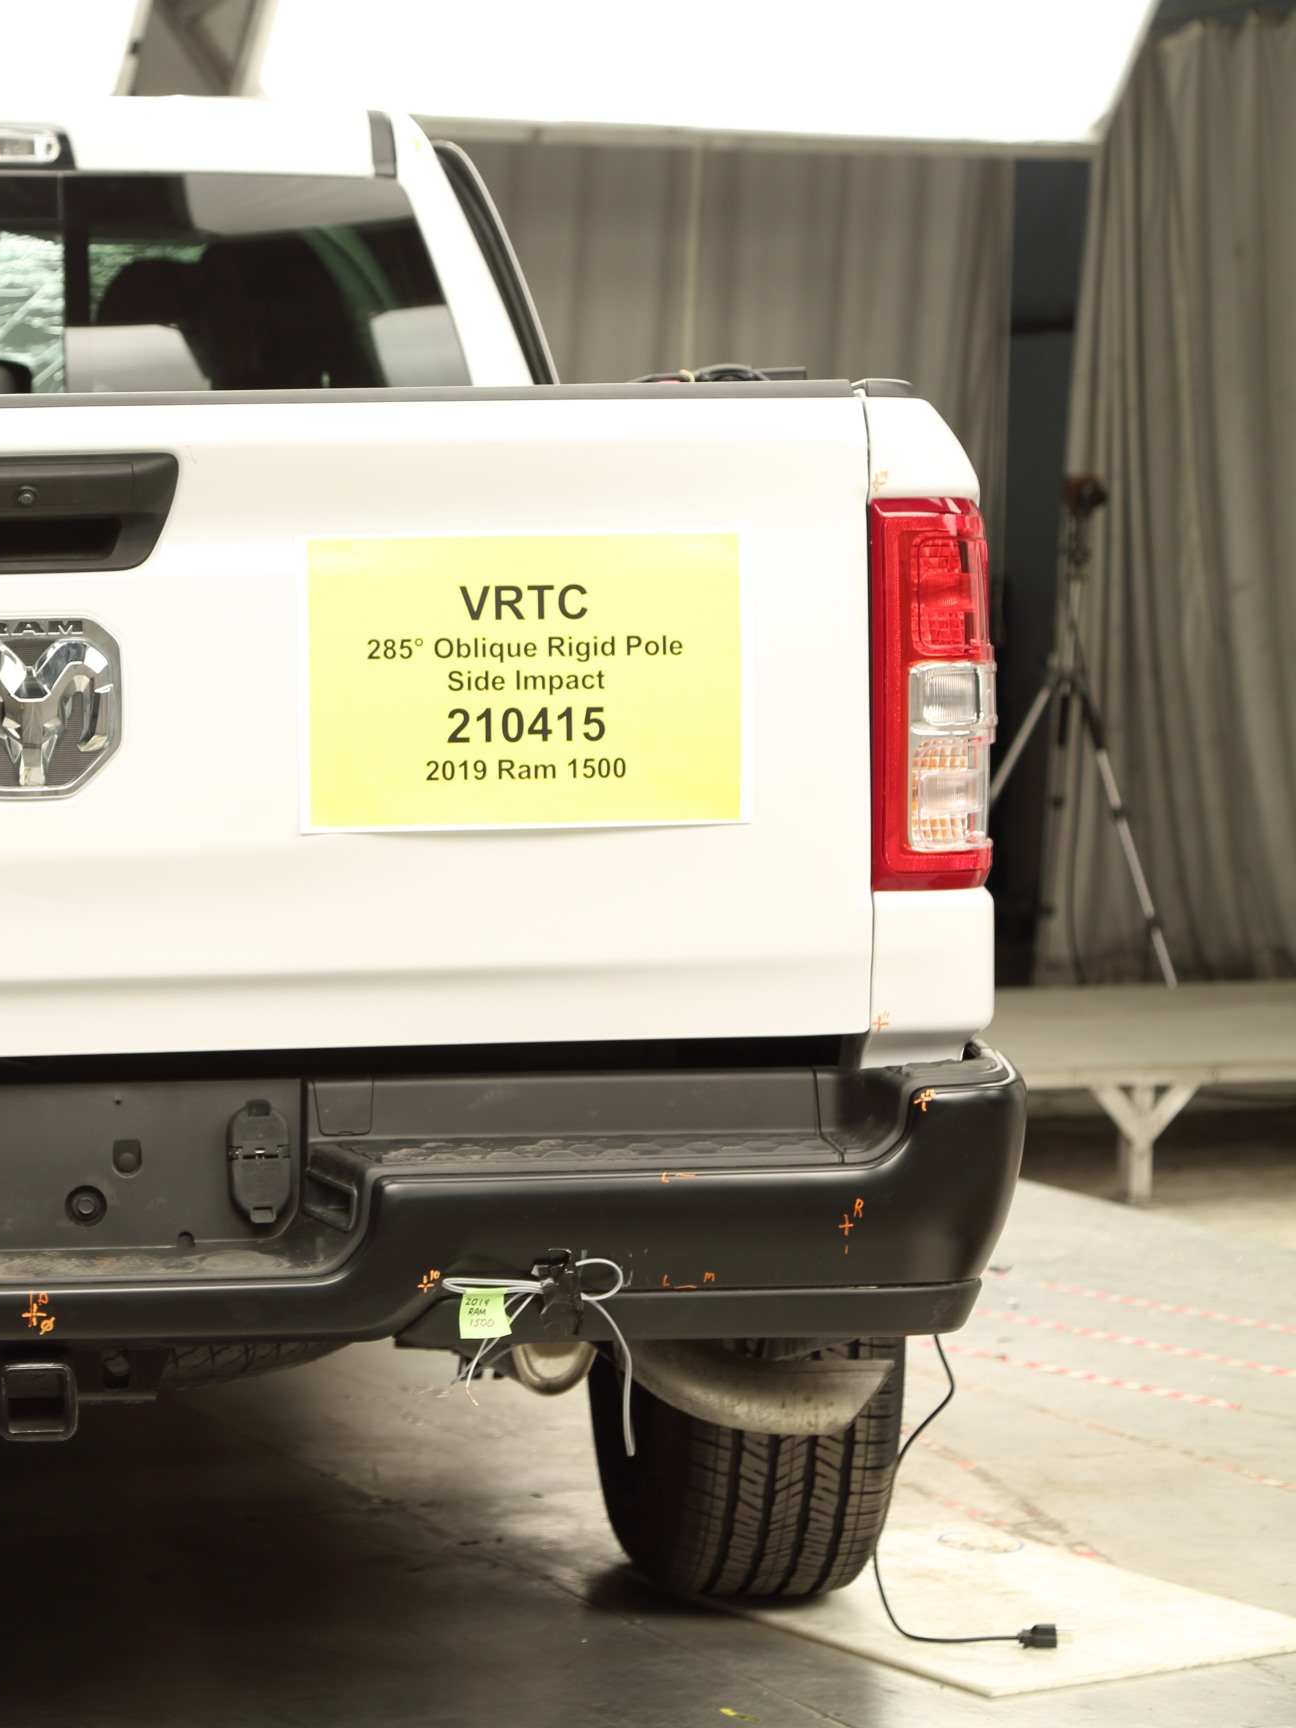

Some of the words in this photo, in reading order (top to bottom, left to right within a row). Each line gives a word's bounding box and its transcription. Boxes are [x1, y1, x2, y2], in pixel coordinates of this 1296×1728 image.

[459, 583, 589, 621] VRTC
[366, 637, 425, 661] 285°
[433, 636, 539, 664] Oblique
[547, 635, 617, 662] Rigid
[625, 634, 684, 657] Pole
[447, 670, 506, 692] Side
[515, 669, 606, 696] Impact
[446, 706, 607, 744] 210415
[425, 760, 488, 781] 2019
[497, 759, 557, 780] Ram
[567, 757, 627, 779] 1500
[467, 1307, 487, 1317] RAM
[469, 1317, 496, 1328] 1500
